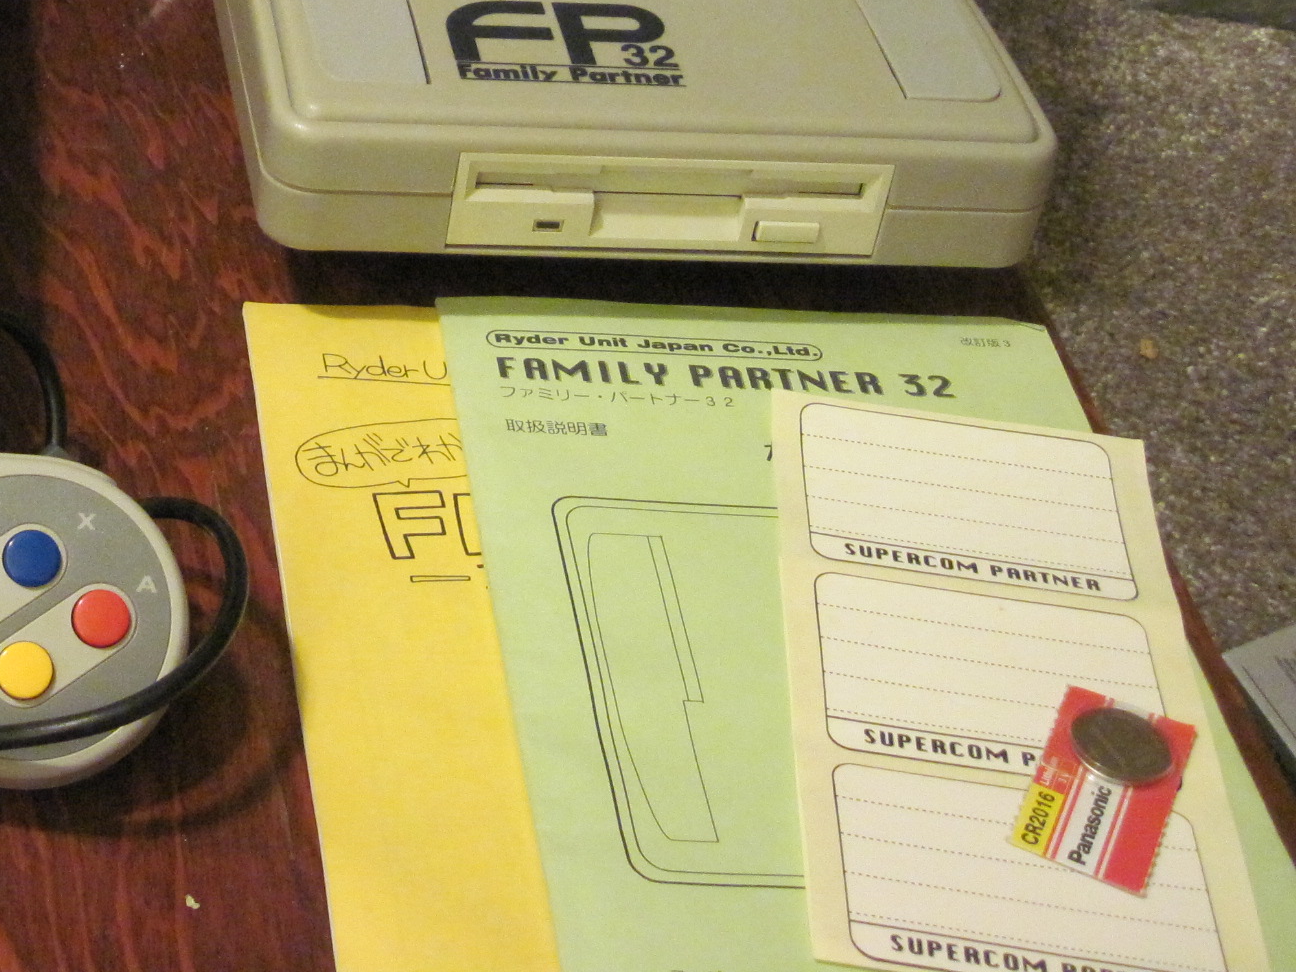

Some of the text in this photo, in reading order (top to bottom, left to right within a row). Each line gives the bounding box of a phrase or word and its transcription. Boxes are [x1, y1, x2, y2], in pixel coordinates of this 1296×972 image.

[446, 0, 665, 66] FP
[621, 44, 679, 68] 32
[457, 64, 683, 86] Family Partner
[495, 333, 819, 358] Ryder Unit Japan Co.,Ltd.
[322, 353, 419, 378] Ryder
[496, 356, 955, 399] FAMILY PARTNER 32
[505, 418, 608, 437] 取扱説明書
[77, 512, 96, 530] X
[844, 543, 1102, 592] SUPERCOM PARTNER
[137, 575, 158, 593] A
[864, 728, 1009, 764] SUPERCOM
[1021, 791, 1055, 845] CR2016
[1067, 785, 1112, 866] Panasonic
[890, 934, 1047, 972] SUPERCOM
